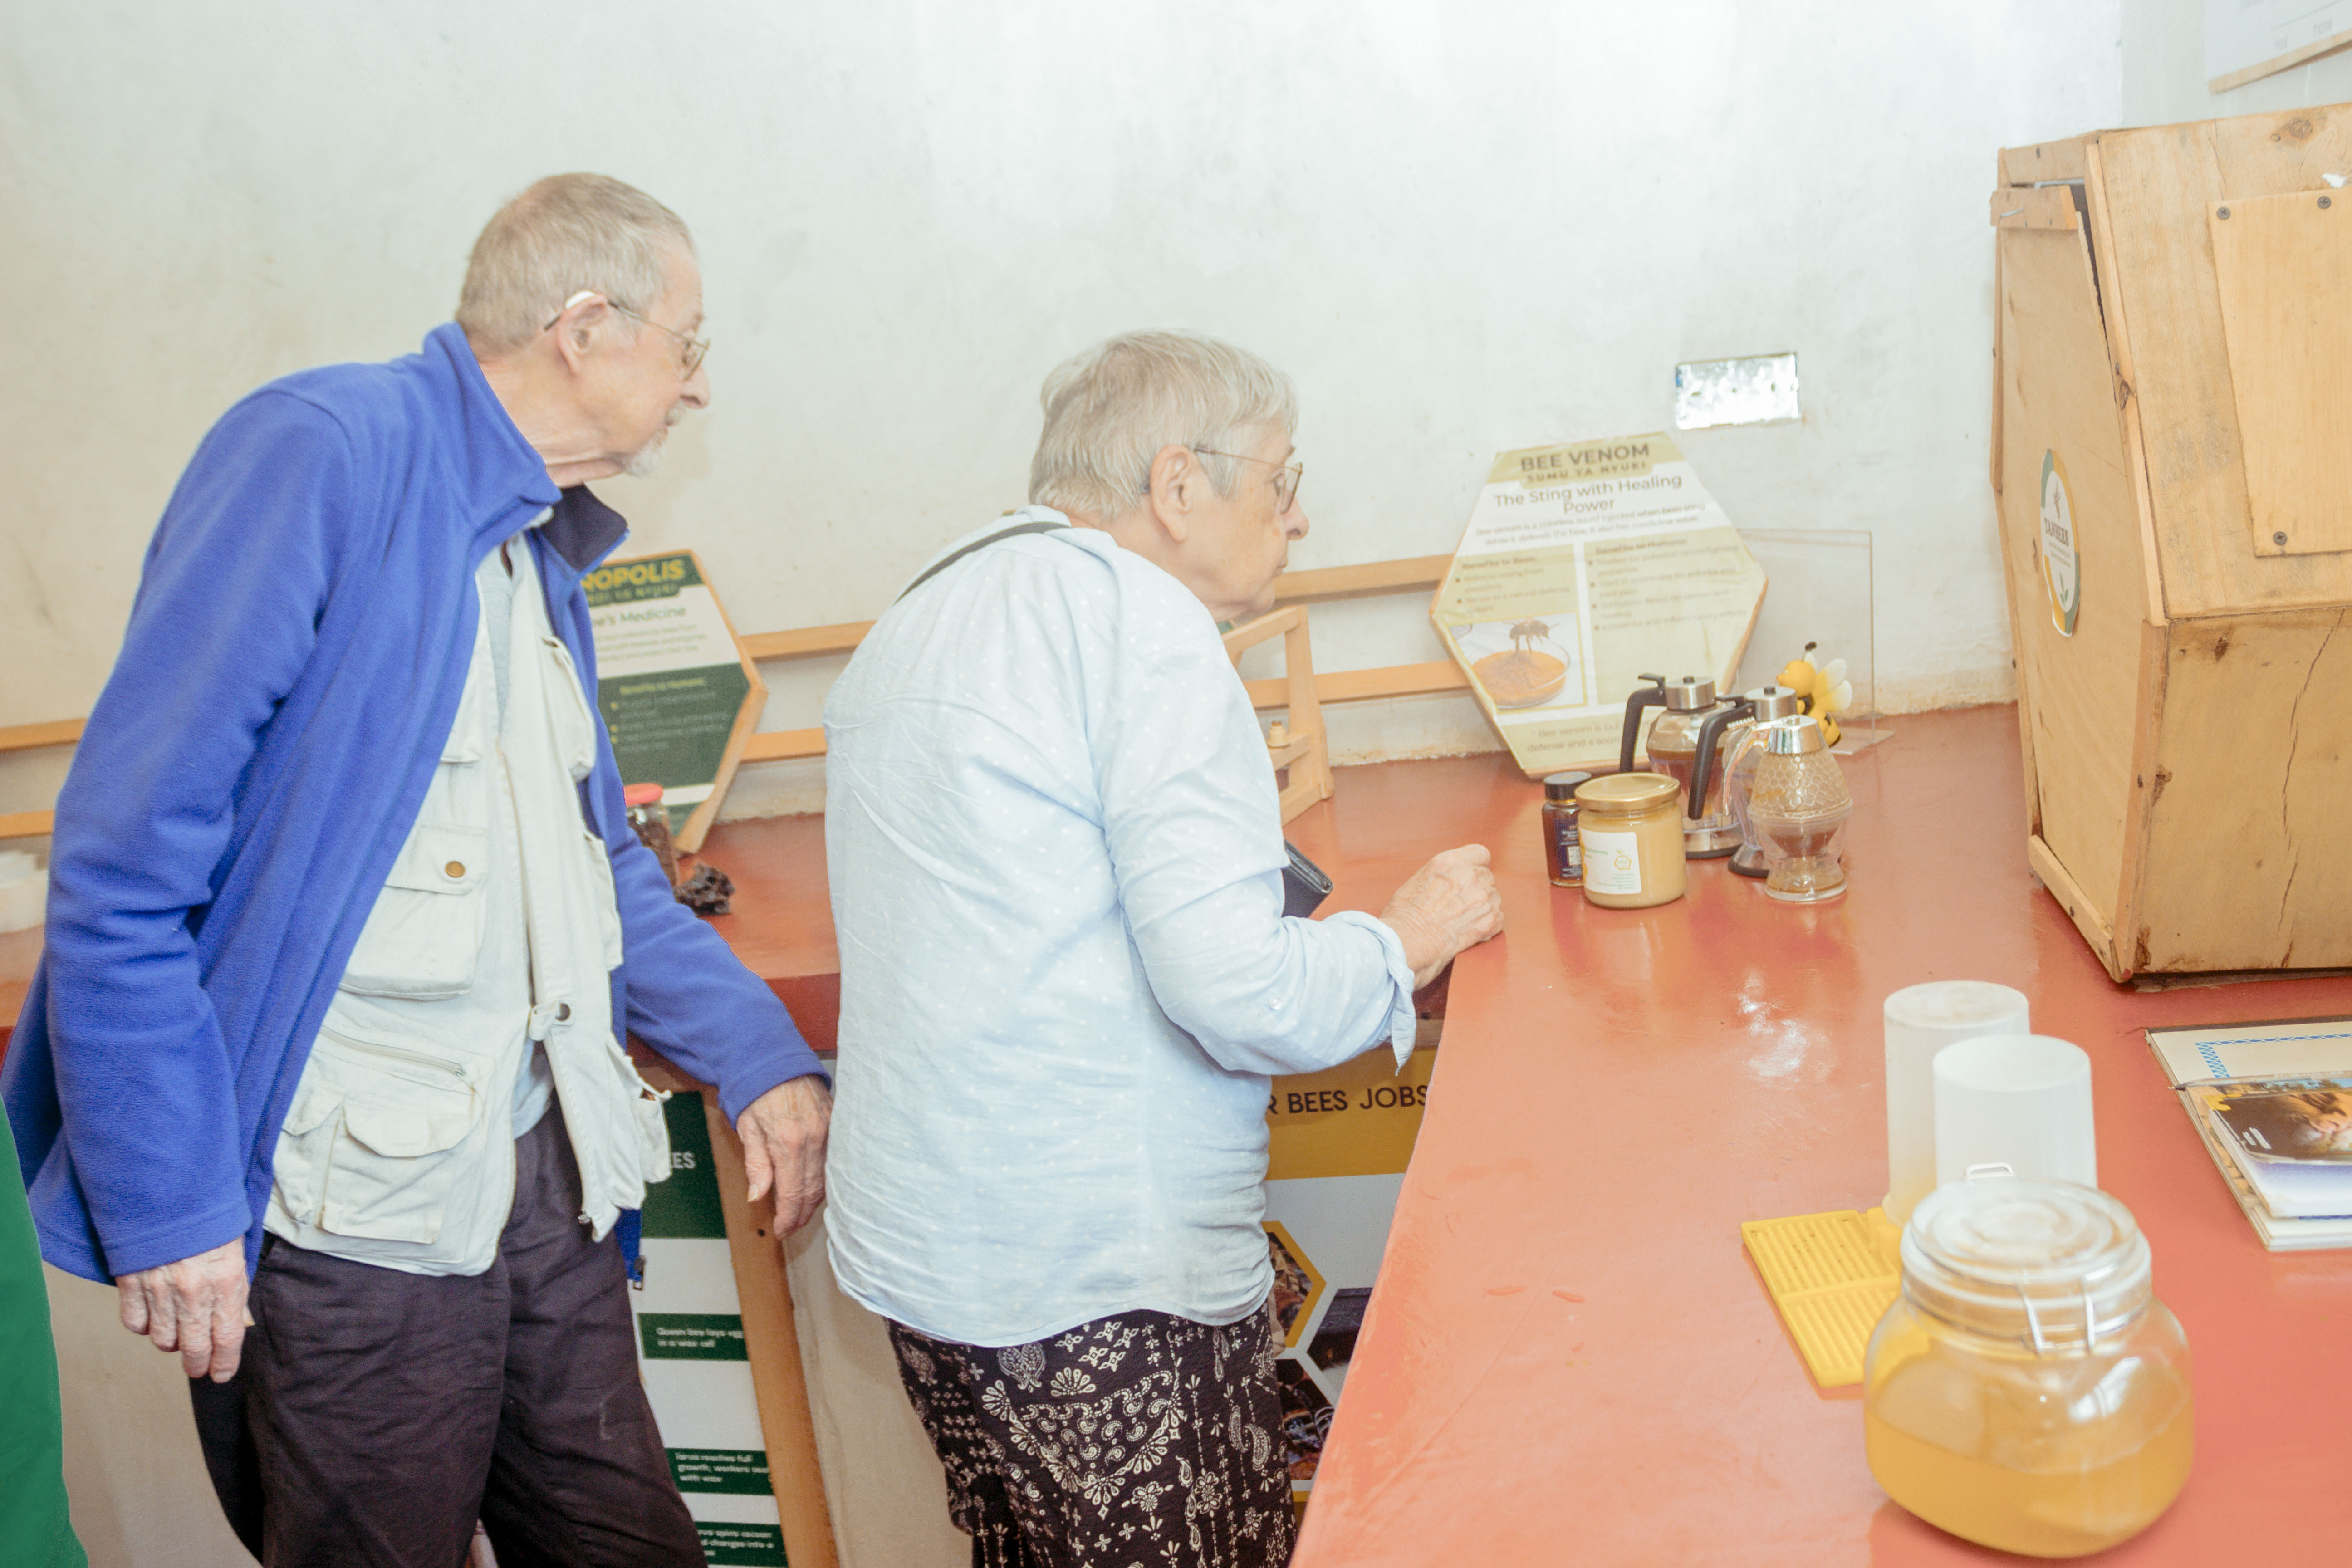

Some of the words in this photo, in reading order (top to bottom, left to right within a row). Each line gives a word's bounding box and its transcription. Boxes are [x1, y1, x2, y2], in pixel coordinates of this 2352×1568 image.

[1520, 452, 1563, 473] BEE
[1569, 442, 1651, 466] VENOM
[1526, 469, 1569, 484] SUMU
[1576, 466, 1594, 479] YA
[1600, 461, 1647, 476] NYUKI
[1494, 493, 1524, 508] The
[1529, 487, 1572, 505] Sting
[1576, 480, 1614, 497] with
[1618, 475, 1683, 493] Healing
[1563, 499, 1616, 515] Power
[1492, 525, 1523, 535] venom
[1636, 508, 1661, 517] when
[1485, 537, 1509, 546] While
[1518, 532, 1551, 542] defends
[581, 559, 685, 590] ROPOLIS
[620, 607, 687, 624] Medicine
[1559, 725, 1593, 735] venom
[1604, 721, 1623, 731] bot
[1527, 741, 1565, 753] defense
[1567, 739, 1587, 749] and
[1287, 1089, 1349, 1114] BEES
[1359, 1084, 1428, 1110] JOBS
[656, 1327, 686, 1336] Queen
[706, 1328, 726, 1338] lays
